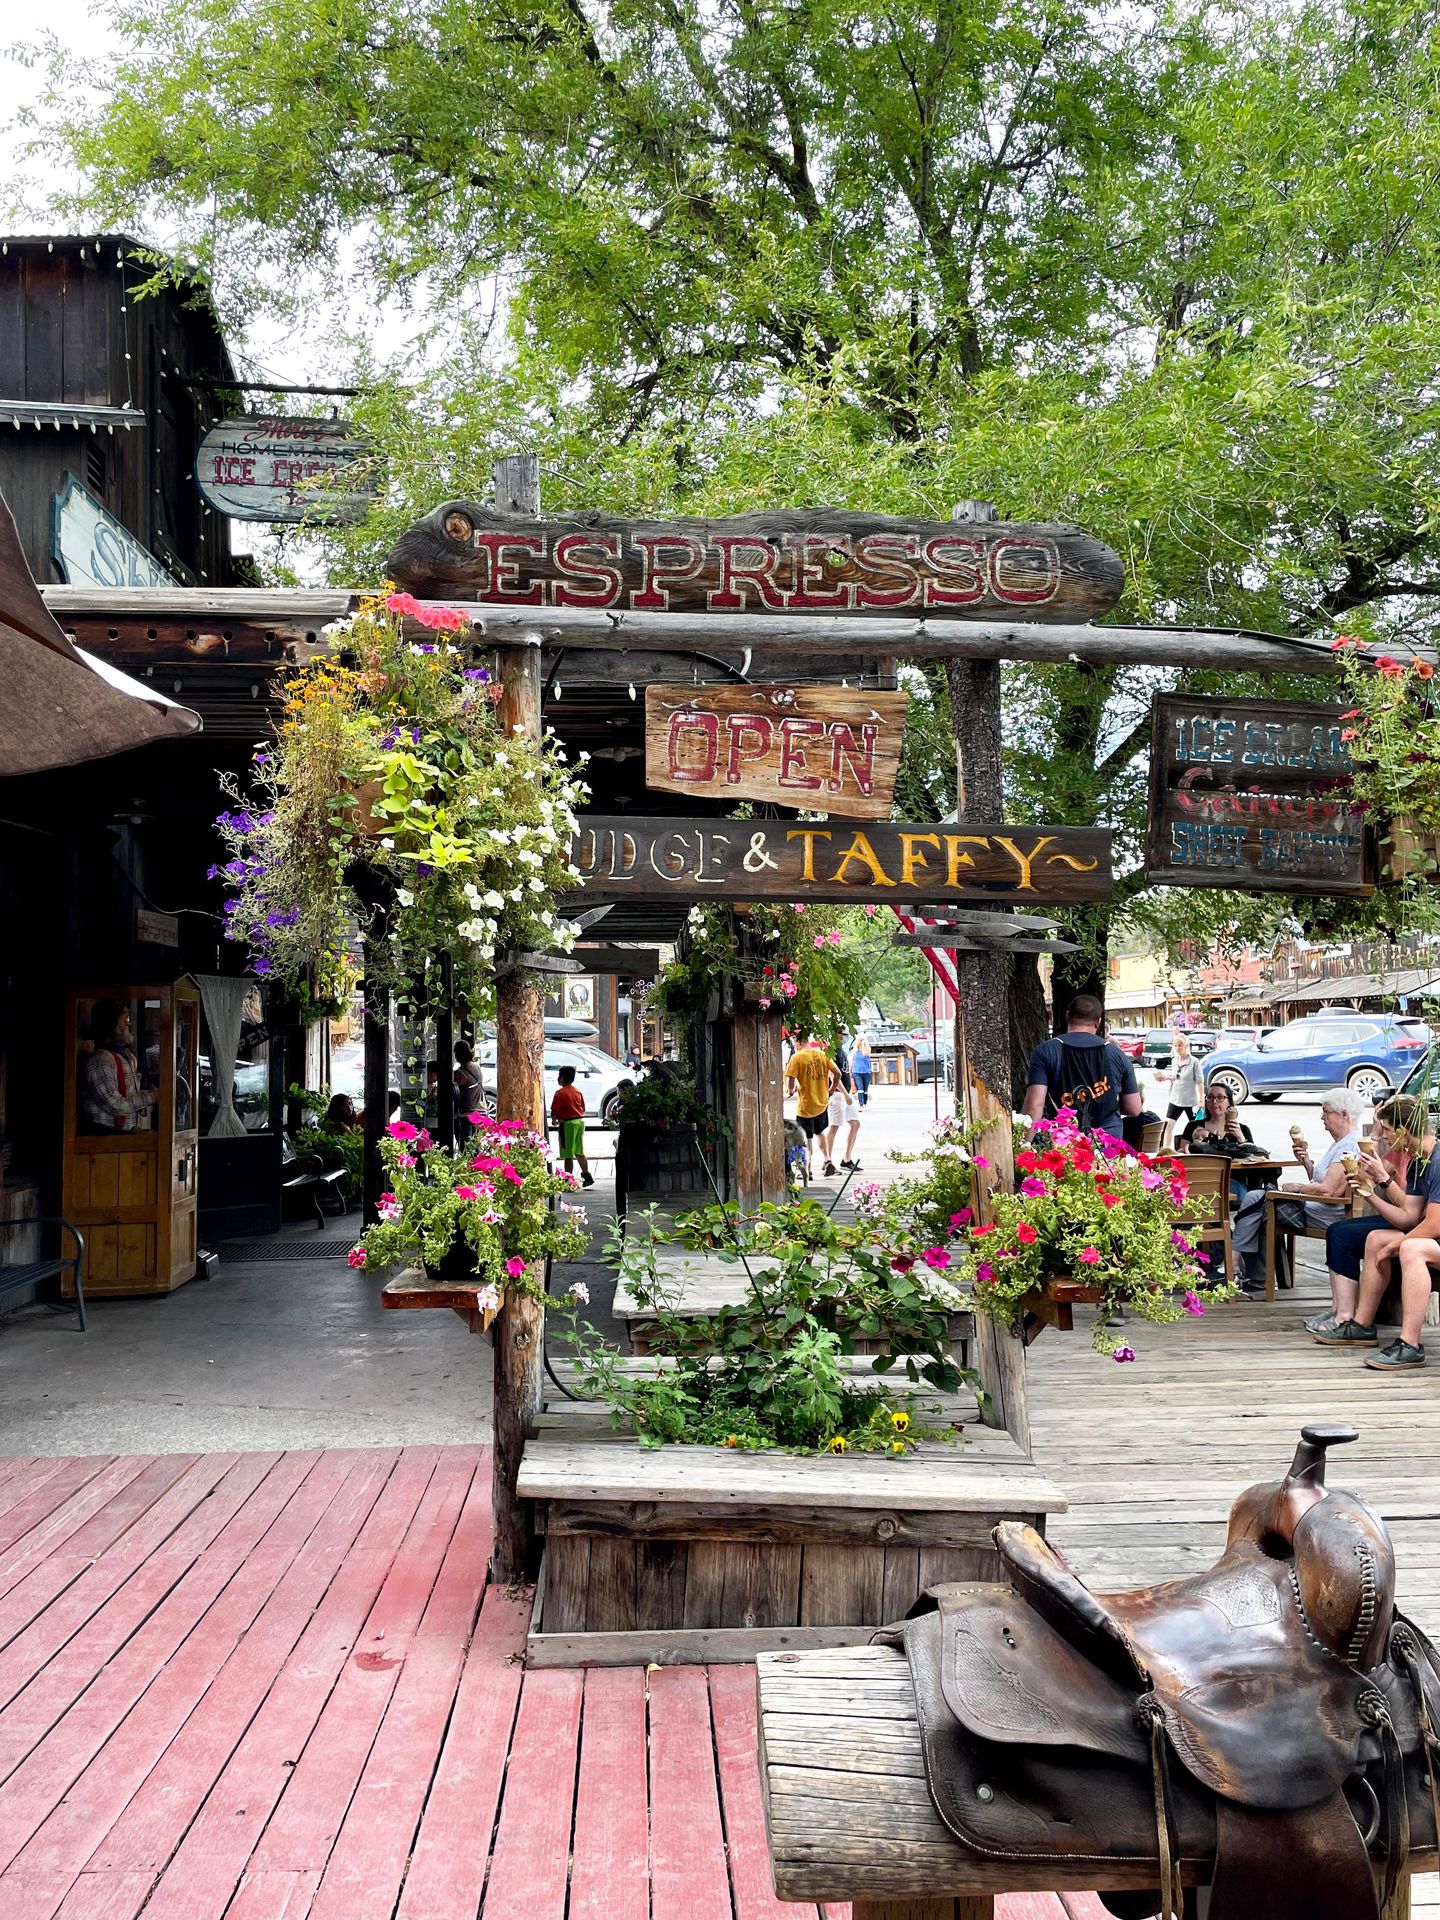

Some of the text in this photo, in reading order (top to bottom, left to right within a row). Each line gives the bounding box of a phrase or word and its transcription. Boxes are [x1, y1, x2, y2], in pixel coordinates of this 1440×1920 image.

[214, 455, 256, 484] ICE
[476, 532, 1061, 610] ESPRESSO
[666, 710, 879, 797] OPEN
[1175, 715, 1237, 763] ICE
[568, 828, 1058, 893] UDGE & TAFFY
[238, 1025, 270, 1052] PEN
